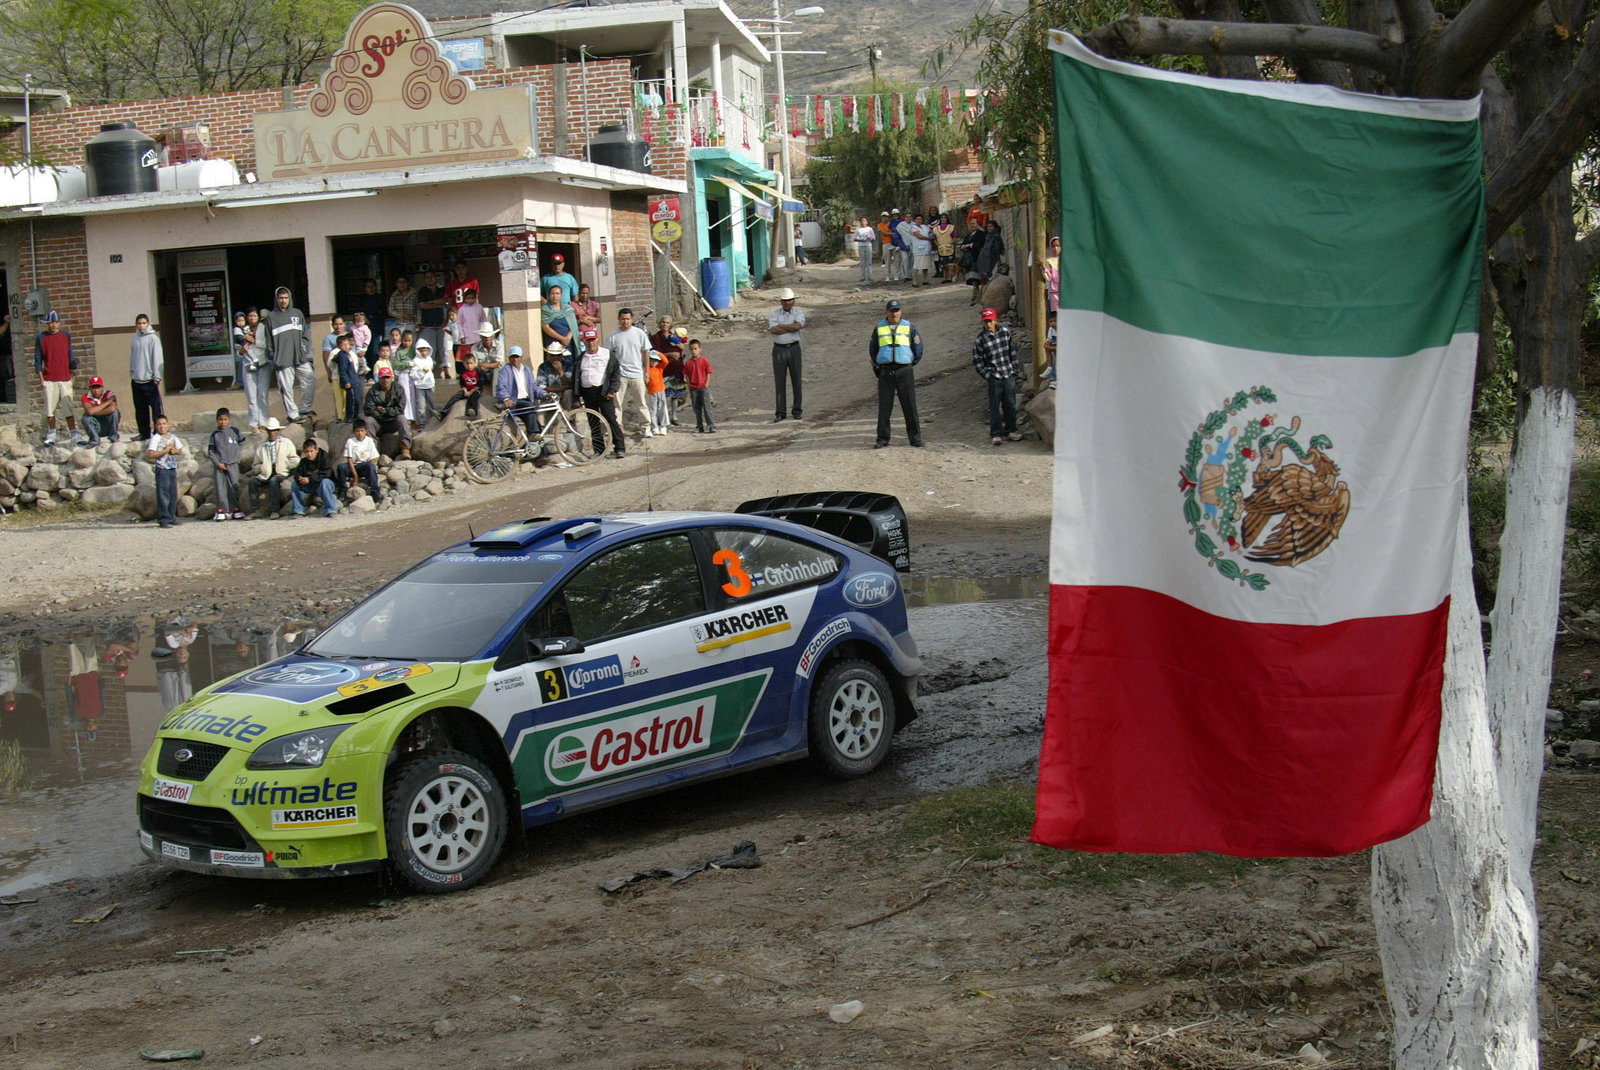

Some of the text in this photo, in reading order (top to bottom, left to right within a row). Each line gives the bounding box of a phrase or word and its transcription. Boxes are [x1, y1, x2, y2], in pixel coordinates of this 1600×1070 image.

[444, 42, 479, 52] PEPSI
[272, 116, 513, 167] LA CANTERA
[110, 254, 123, 264] 102
[515, 251, 526, 261] 65
[712, 549, 753, 598] 3
[764, 556, 839, 586] Grönholm
[854, 577, 889, 603] Ford
[703, 604, 789, 639] KÄRCHER
[800, 619, 850, 672] BFGoodrich
[544, 670, 561, 701] 3
[569, 662, 621, 690] Corona
[624, 667, 649, 678] PEMEX
[160, 708, 268, 743] ultimate
[590, 705, 704, 772] Castrol
[160, 782, 189, 800] Castrol
[231, 777, 358, 806] ultimate
[235, 775, 248, 786] bp
[283, 806, 356, 822] KÄRCHER
[213, 851, 261, 862] BFGoodrich
